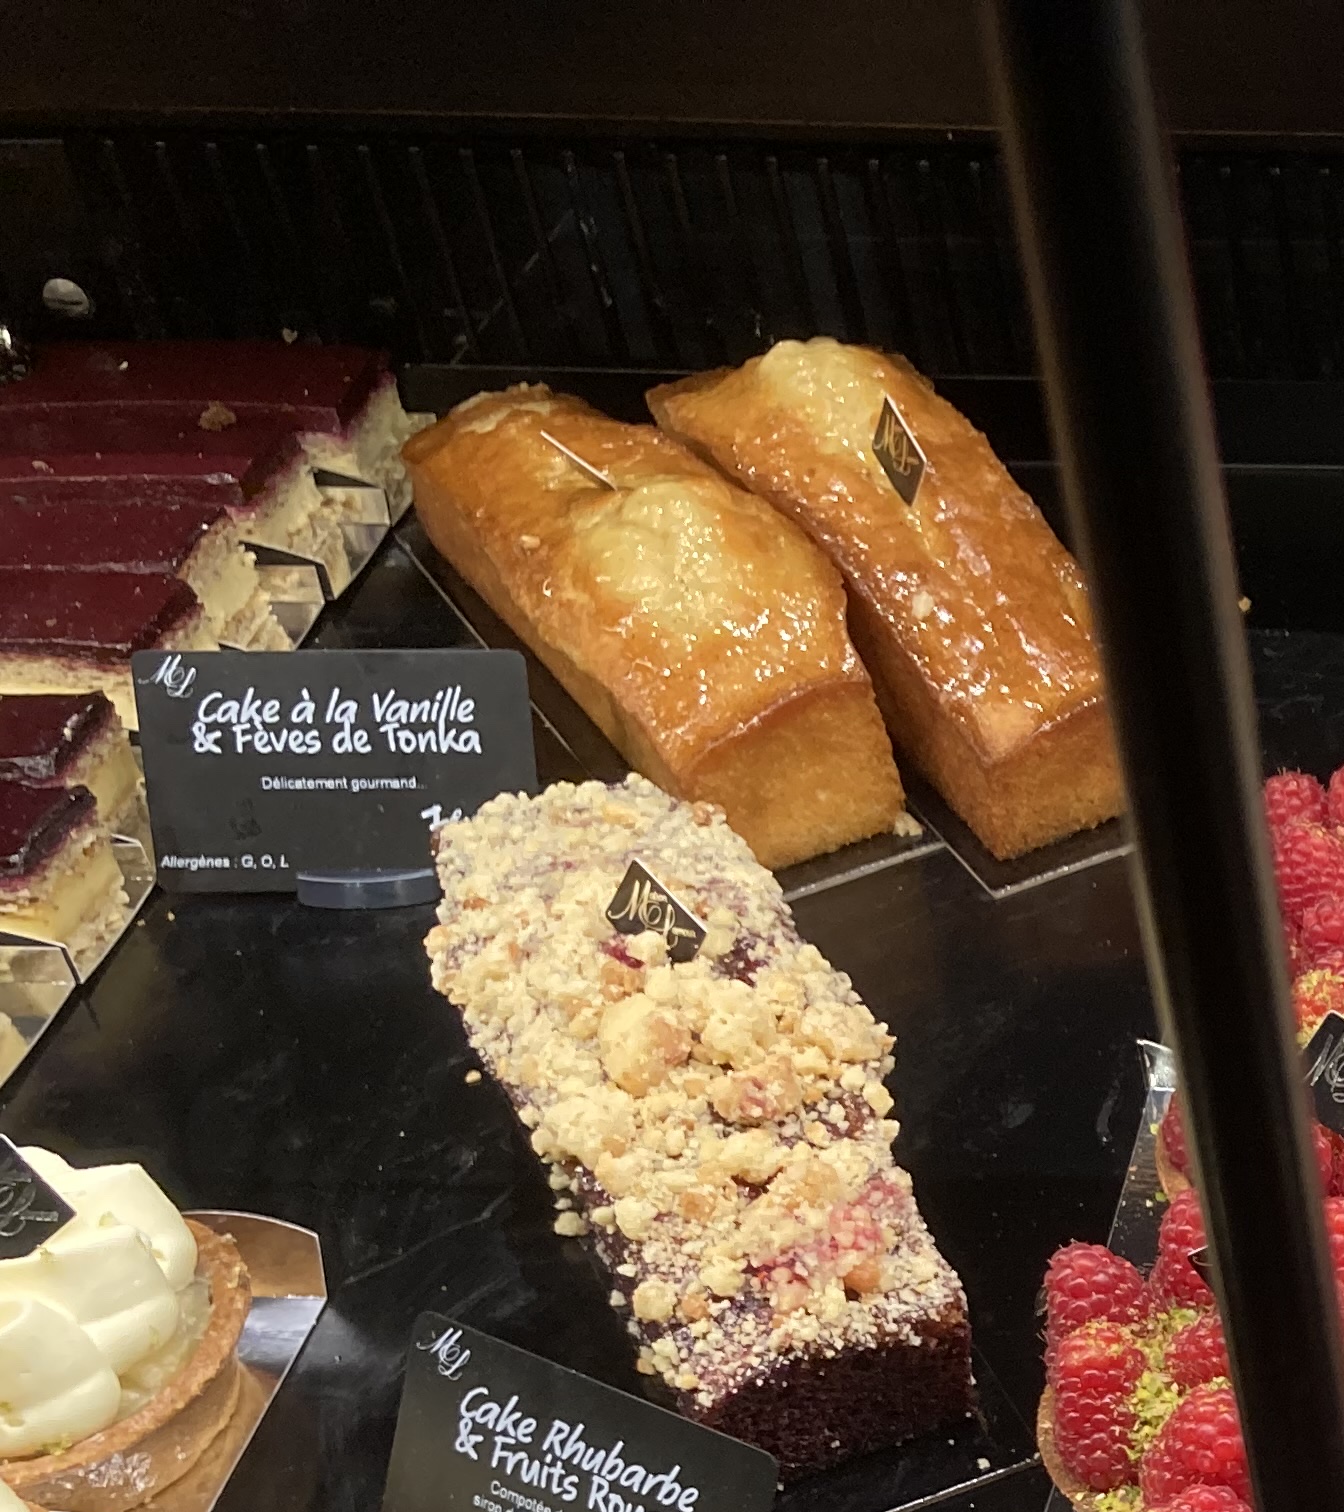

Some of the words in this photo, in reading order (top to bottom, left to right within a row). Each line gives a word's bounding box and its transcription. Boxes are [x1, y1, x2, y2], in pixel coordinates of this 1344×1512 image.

[196, 687, 281, 725] Cake
[290, 687, 316, 725] à
[325, 687, 359, 725] la
[373, 685, 476, 725] Vanille
[193, 724, 223, 755] &
[232, 718, 323, 755] Fèves
[332, 719, 373, 755] de
[379, 717, 483, 755] Tonka
[261, 775, 349, 791] Délicatement
[160, 854, 231, 871] Allergènes
[459, 1386, 539, 1444] Cake
[454, 1417, 484, 1461] &
[490, 1434, 580, 1503] Fruits
